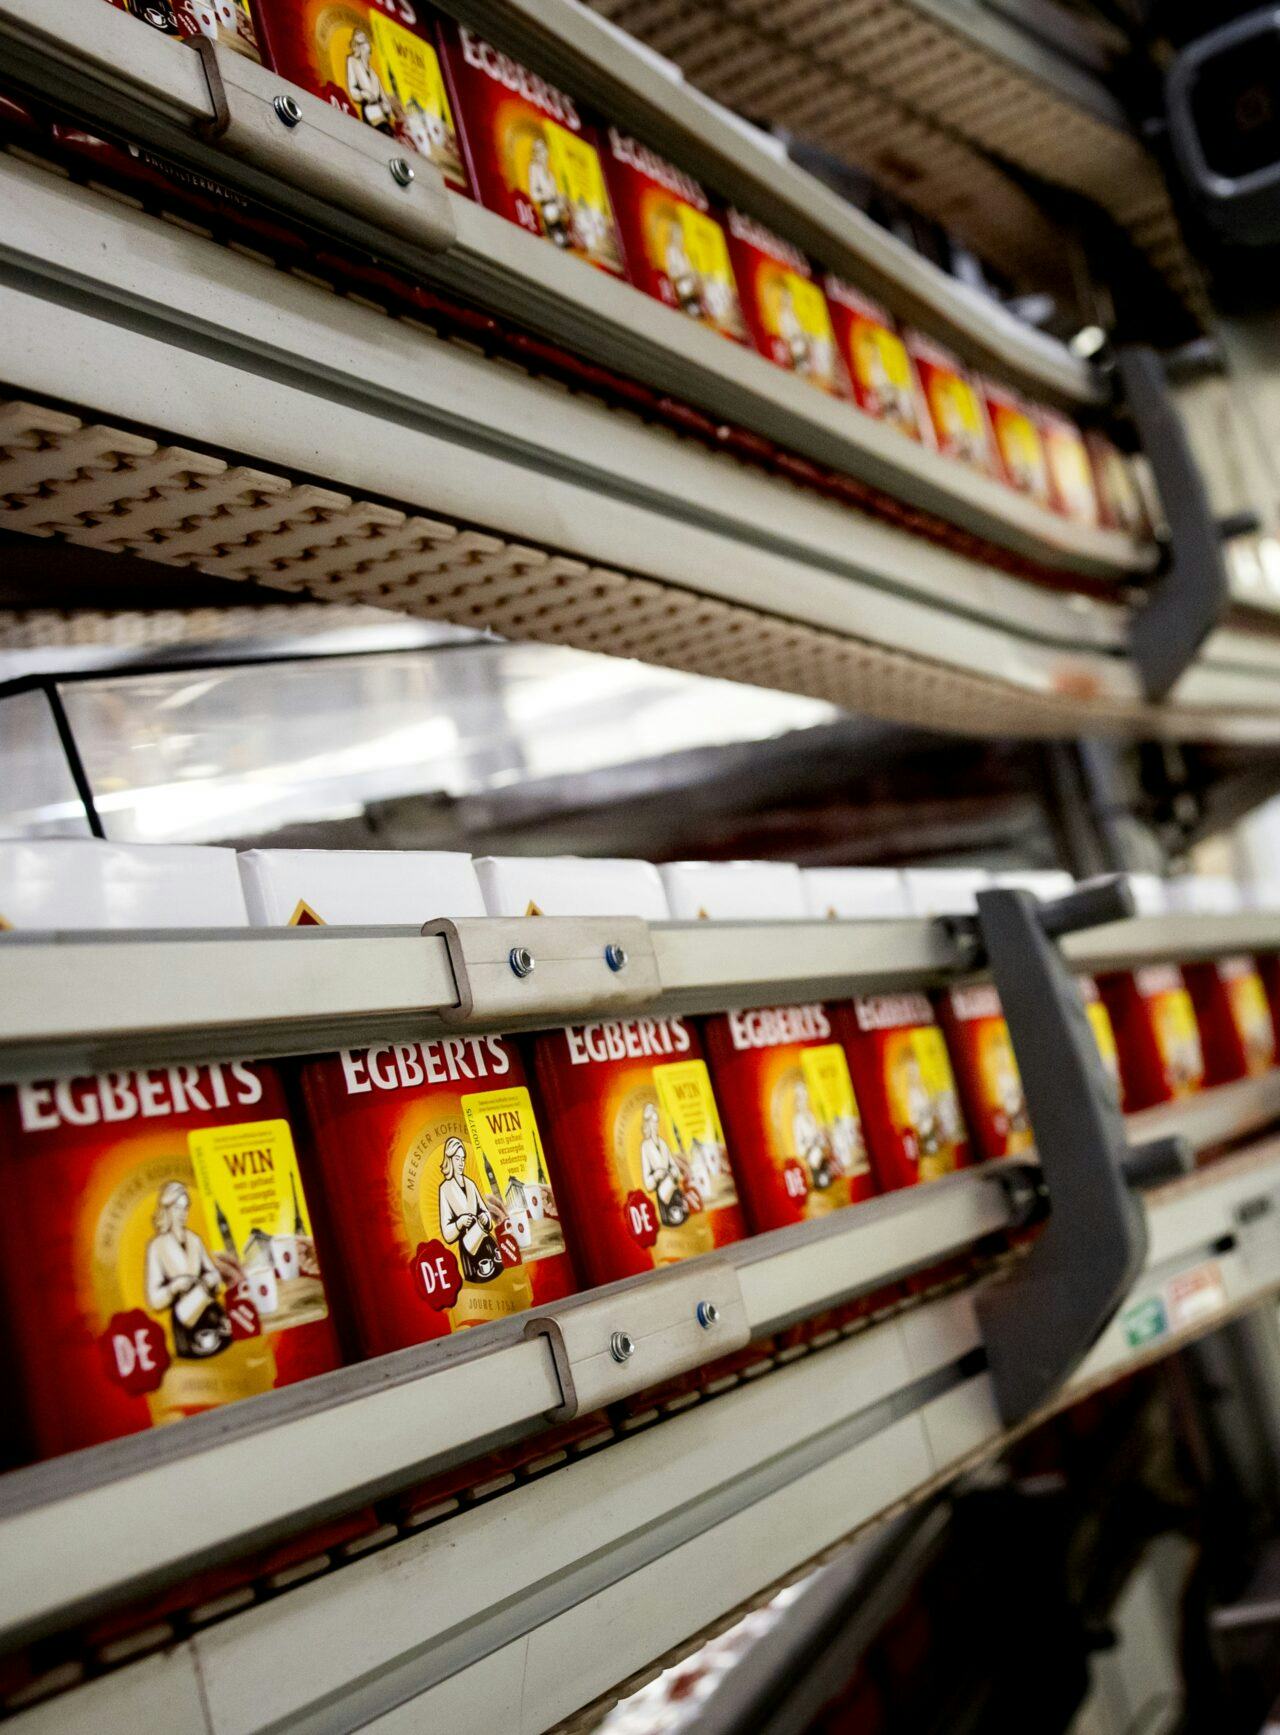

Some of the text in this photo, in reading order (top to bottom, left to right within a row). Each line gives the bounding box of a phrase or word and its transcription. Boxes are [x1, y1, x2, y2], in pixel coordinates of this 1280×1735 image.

[340, 1034, 510, 1095] EGBERTS
[565, 1015, 691, 1065] EGBERTS
[18, 1060, 263, 1133] EGBERTS
[486, 1110, 522, 1135] WIN
[223, 1147, 275, 1177] WIN
[407, 1133, 433, 1191] MEESTER
